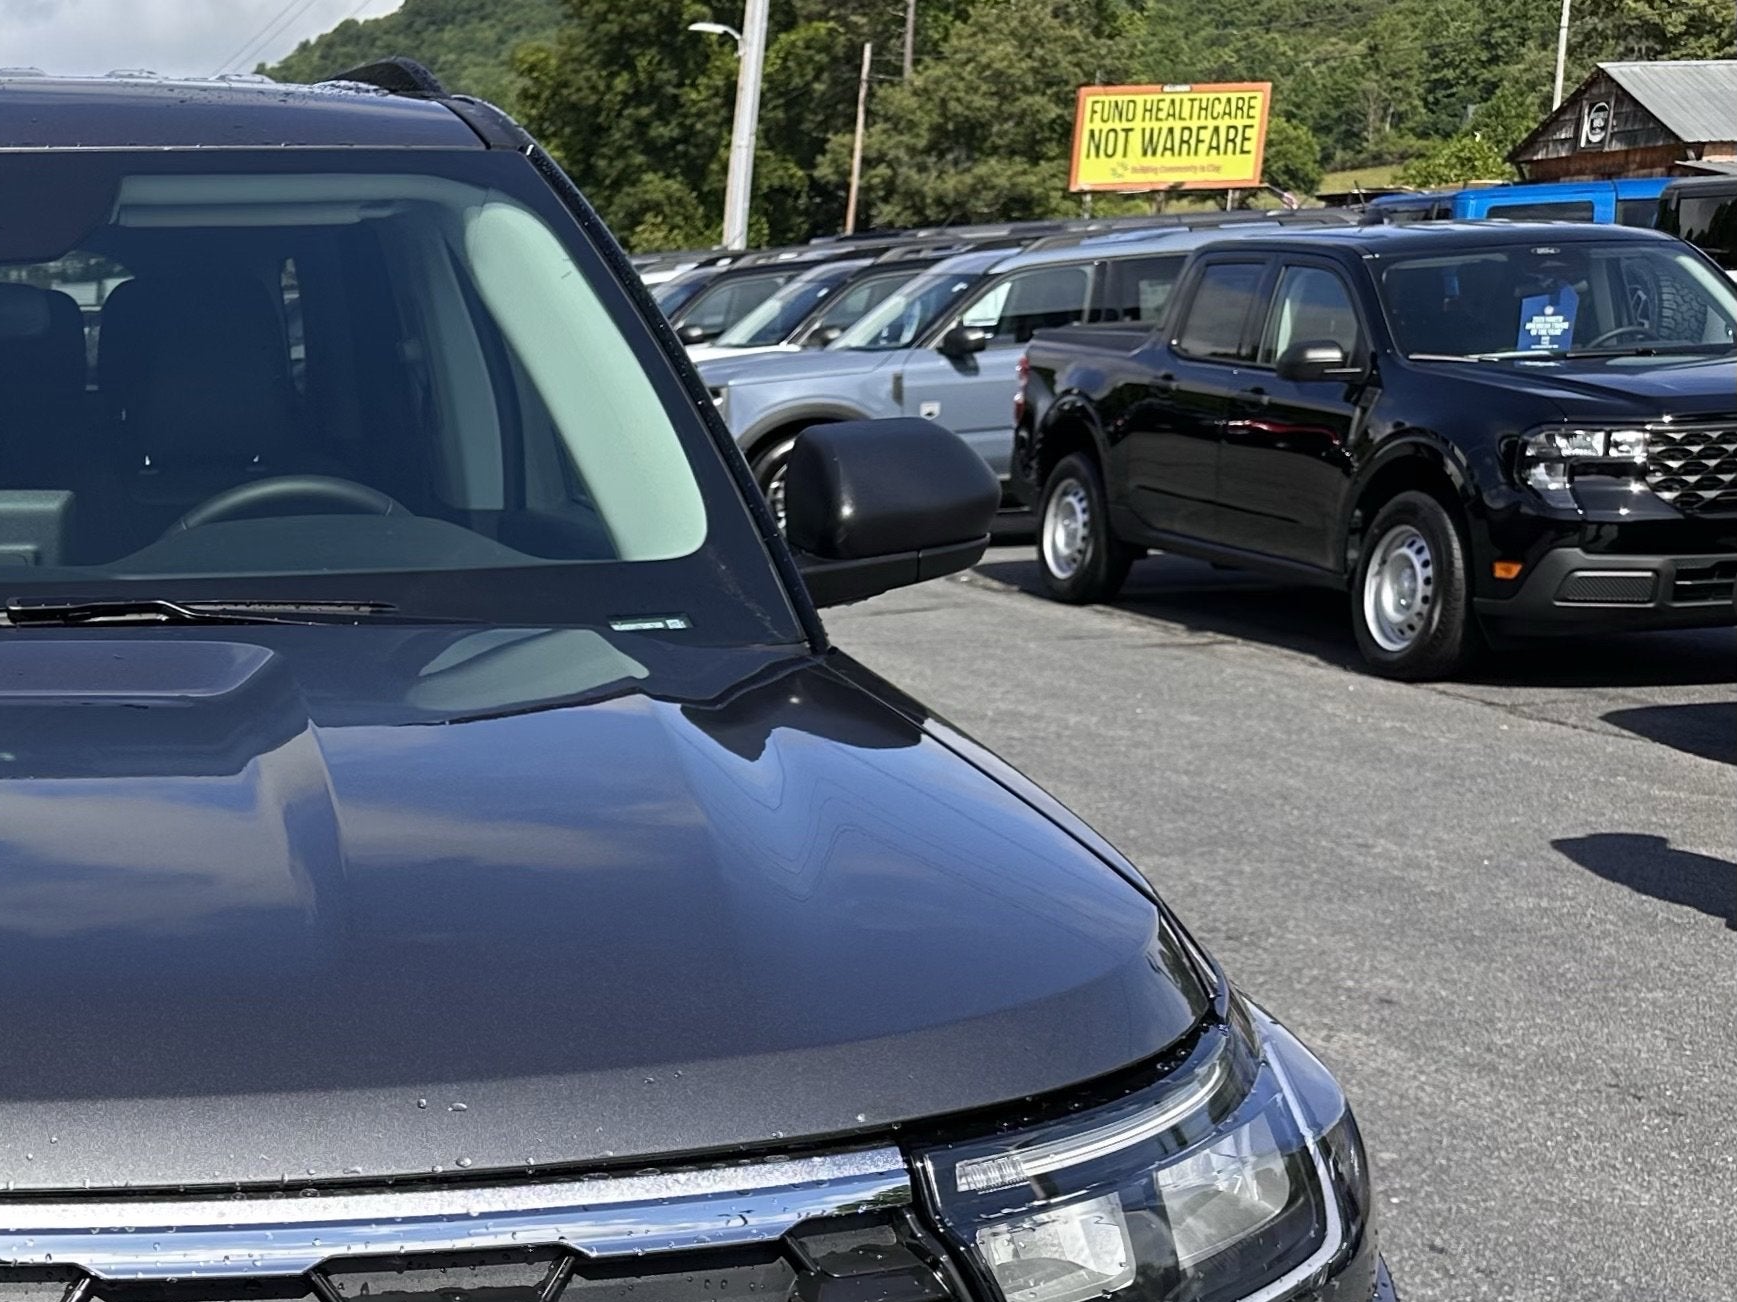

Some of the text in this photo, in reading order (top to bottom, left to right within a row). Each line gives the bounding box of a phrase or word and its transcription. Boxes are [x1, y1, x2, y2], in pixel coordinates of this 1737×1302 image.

[1089, 95, 1258, 124] FUND HEALTHCARE
[1086, 124, 1255, 159] NOT WARFARE
